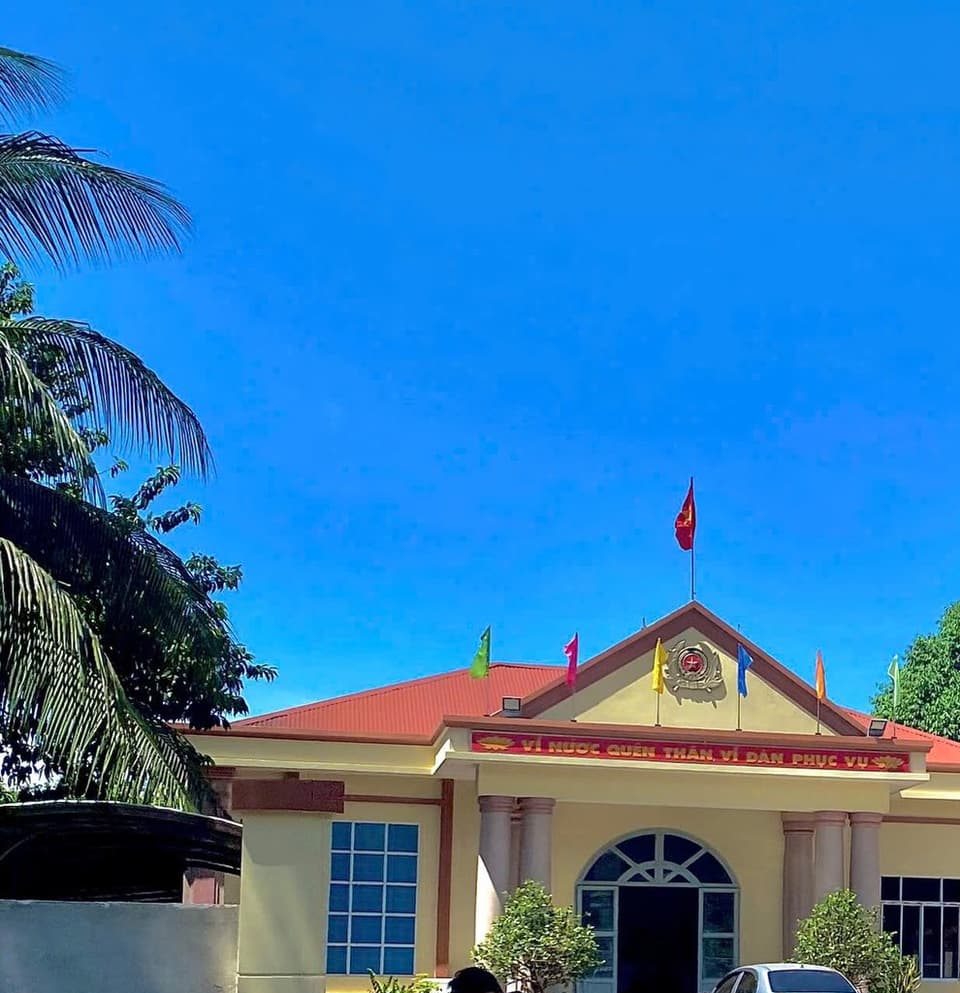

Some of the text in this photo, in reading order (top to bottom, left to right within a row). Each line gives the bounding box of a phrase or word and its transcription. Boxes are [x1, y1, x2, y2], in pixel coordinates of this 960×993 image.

[607, 741, 656, 758] QUÊN
[746, 749, 784, 764] DÂN
[791, 752, 838, 768] PHỤC
[844, 755, 869, 770] VỤ
